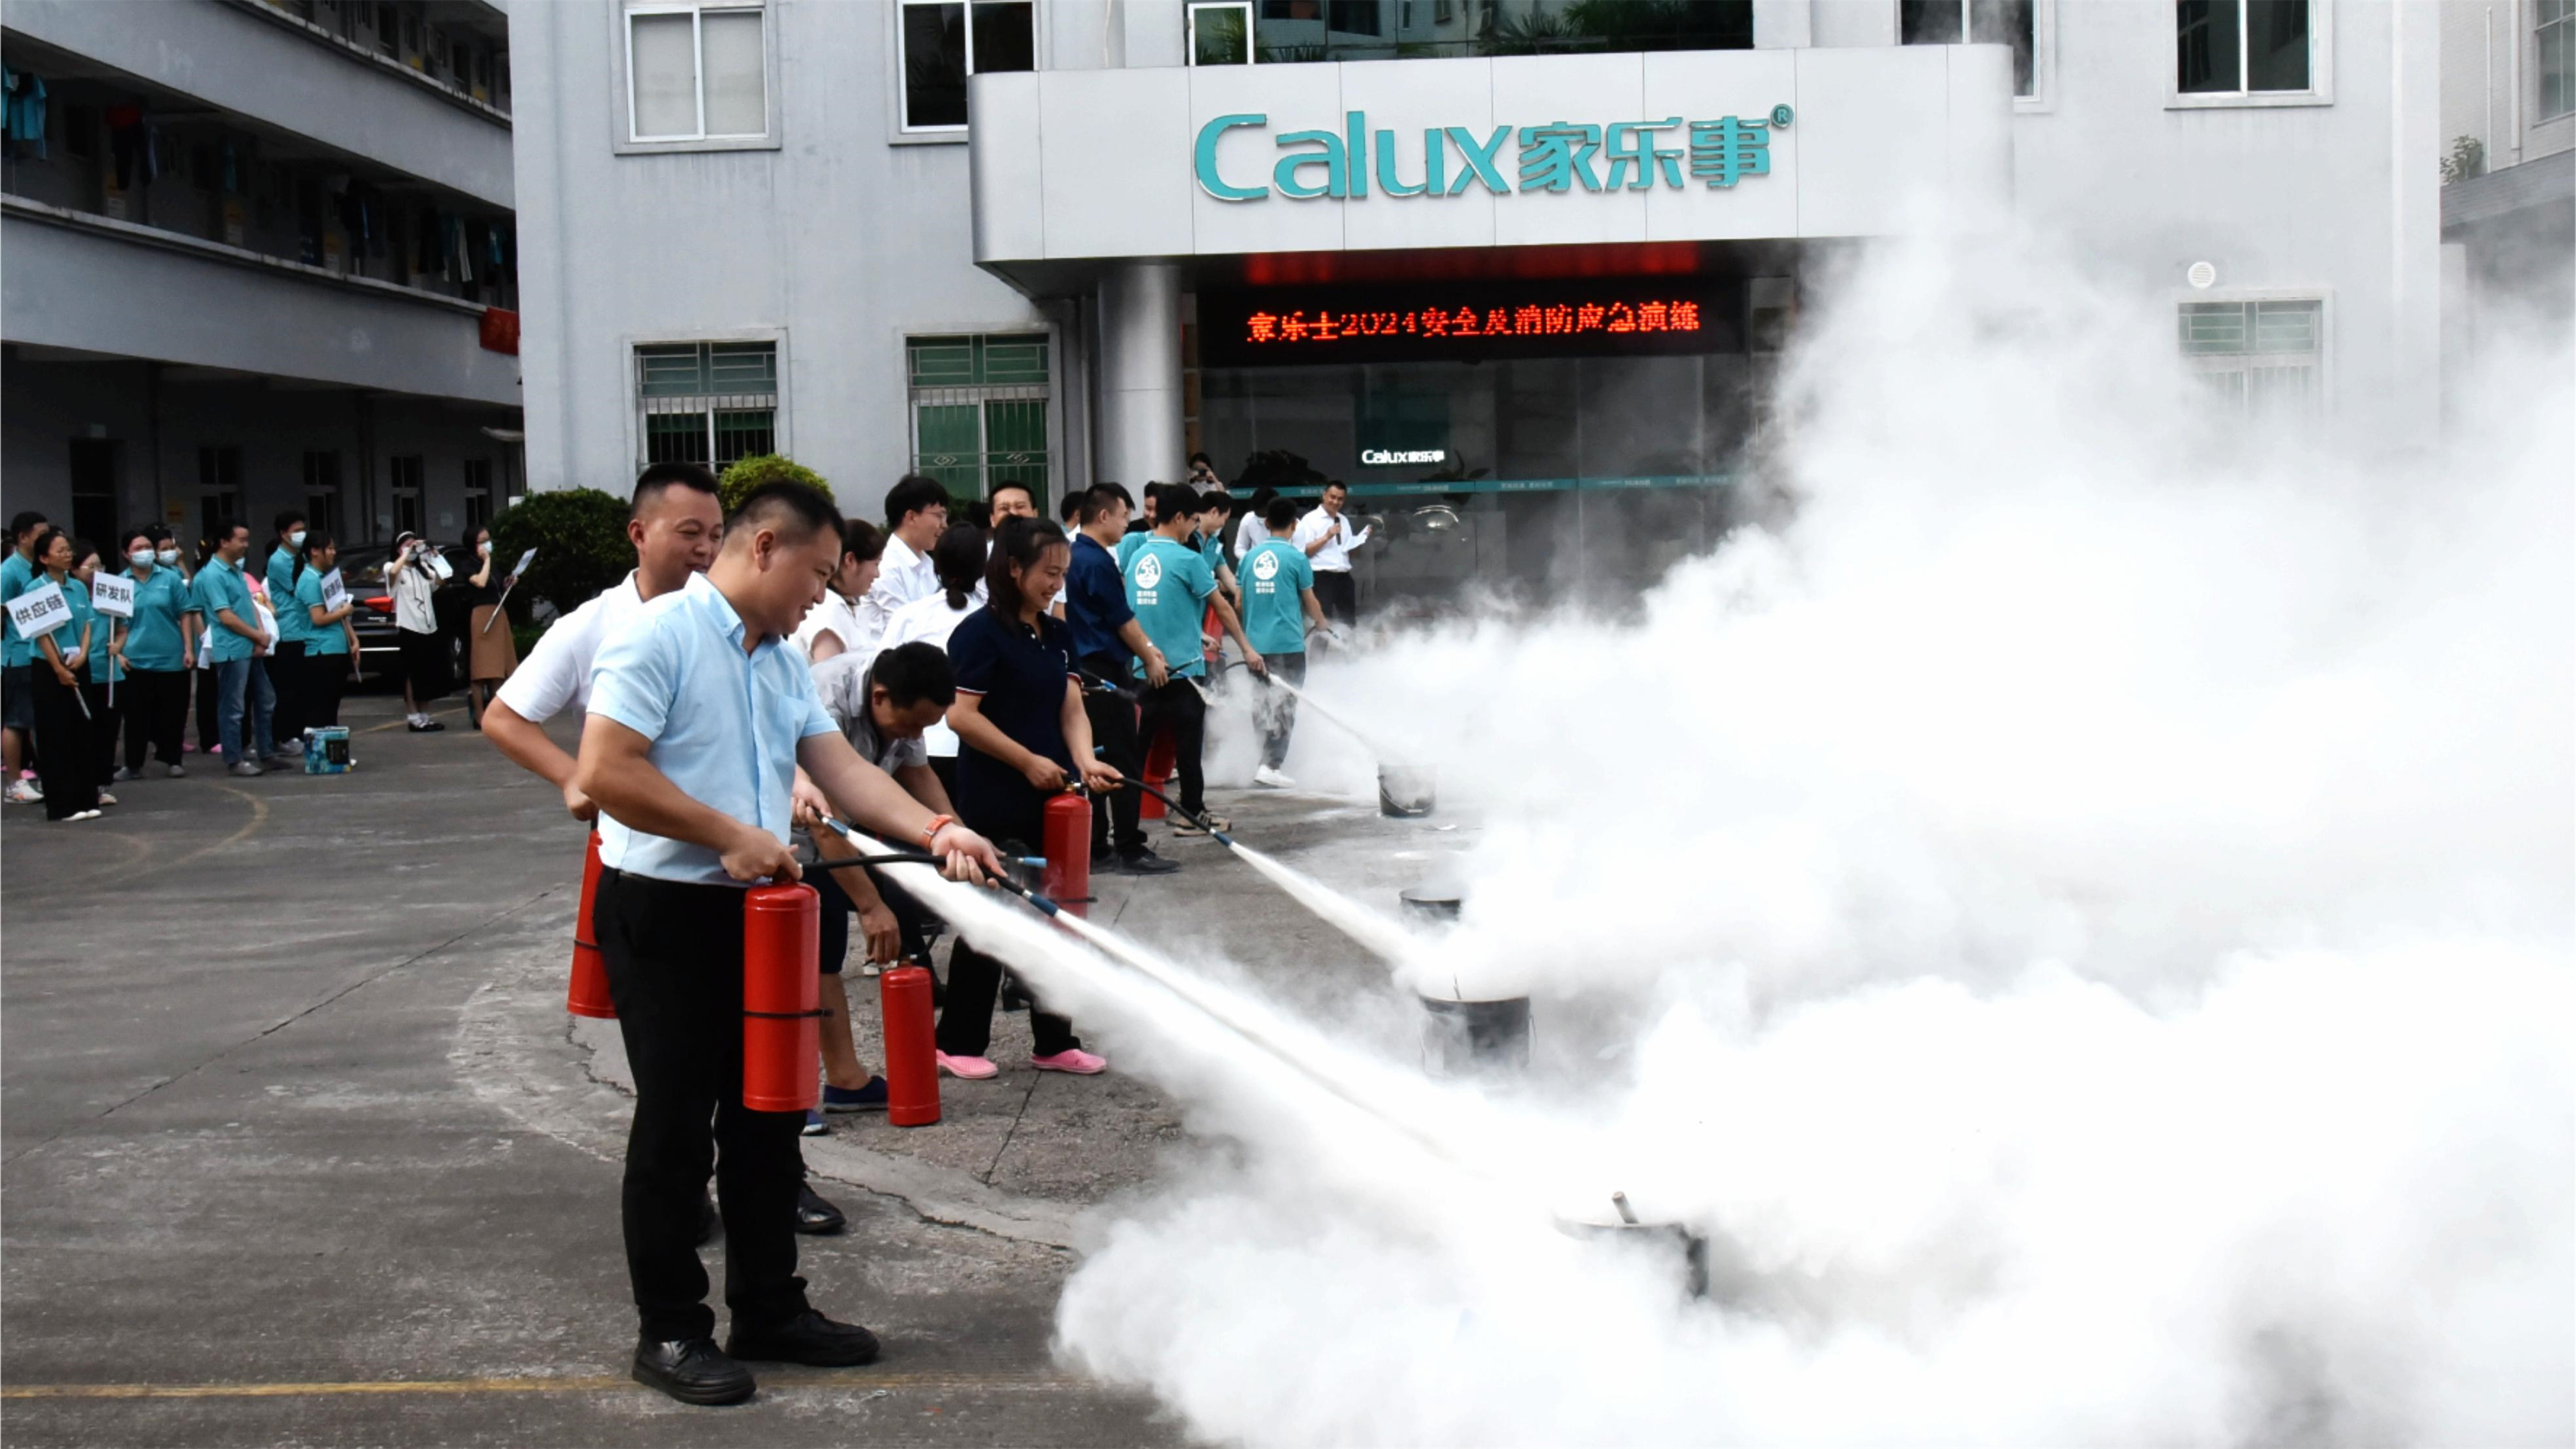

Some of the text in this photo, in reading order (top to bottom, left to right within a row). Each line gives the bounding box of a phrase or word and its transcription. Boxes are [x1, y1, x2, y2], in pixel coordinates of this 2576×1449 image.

[95, 582, 132, 604] 研发队
[15, 593, 65, 625] 供应链
